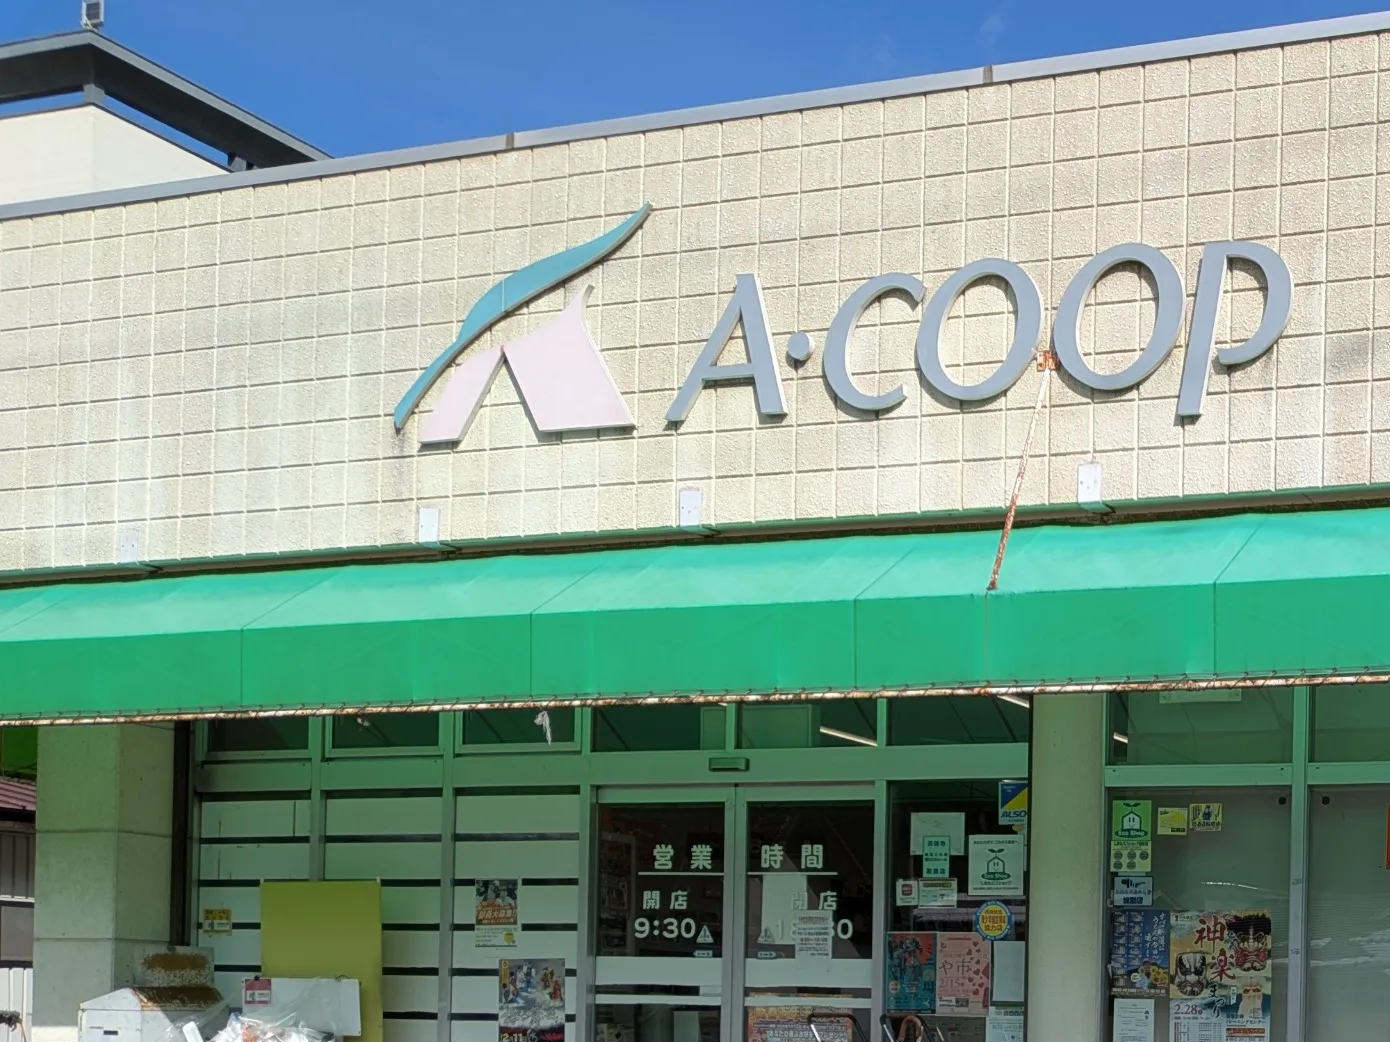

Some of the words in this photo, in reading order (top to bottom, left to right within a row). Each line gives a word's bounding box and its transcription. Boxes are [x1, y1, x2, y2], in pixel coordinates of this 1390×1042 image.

[652, 844, 713, 870] 営業
[761, 844, 824, 870] 時間
[642, 890, 689, 910] 開店
[634, 917, 696, 939] 9:30
